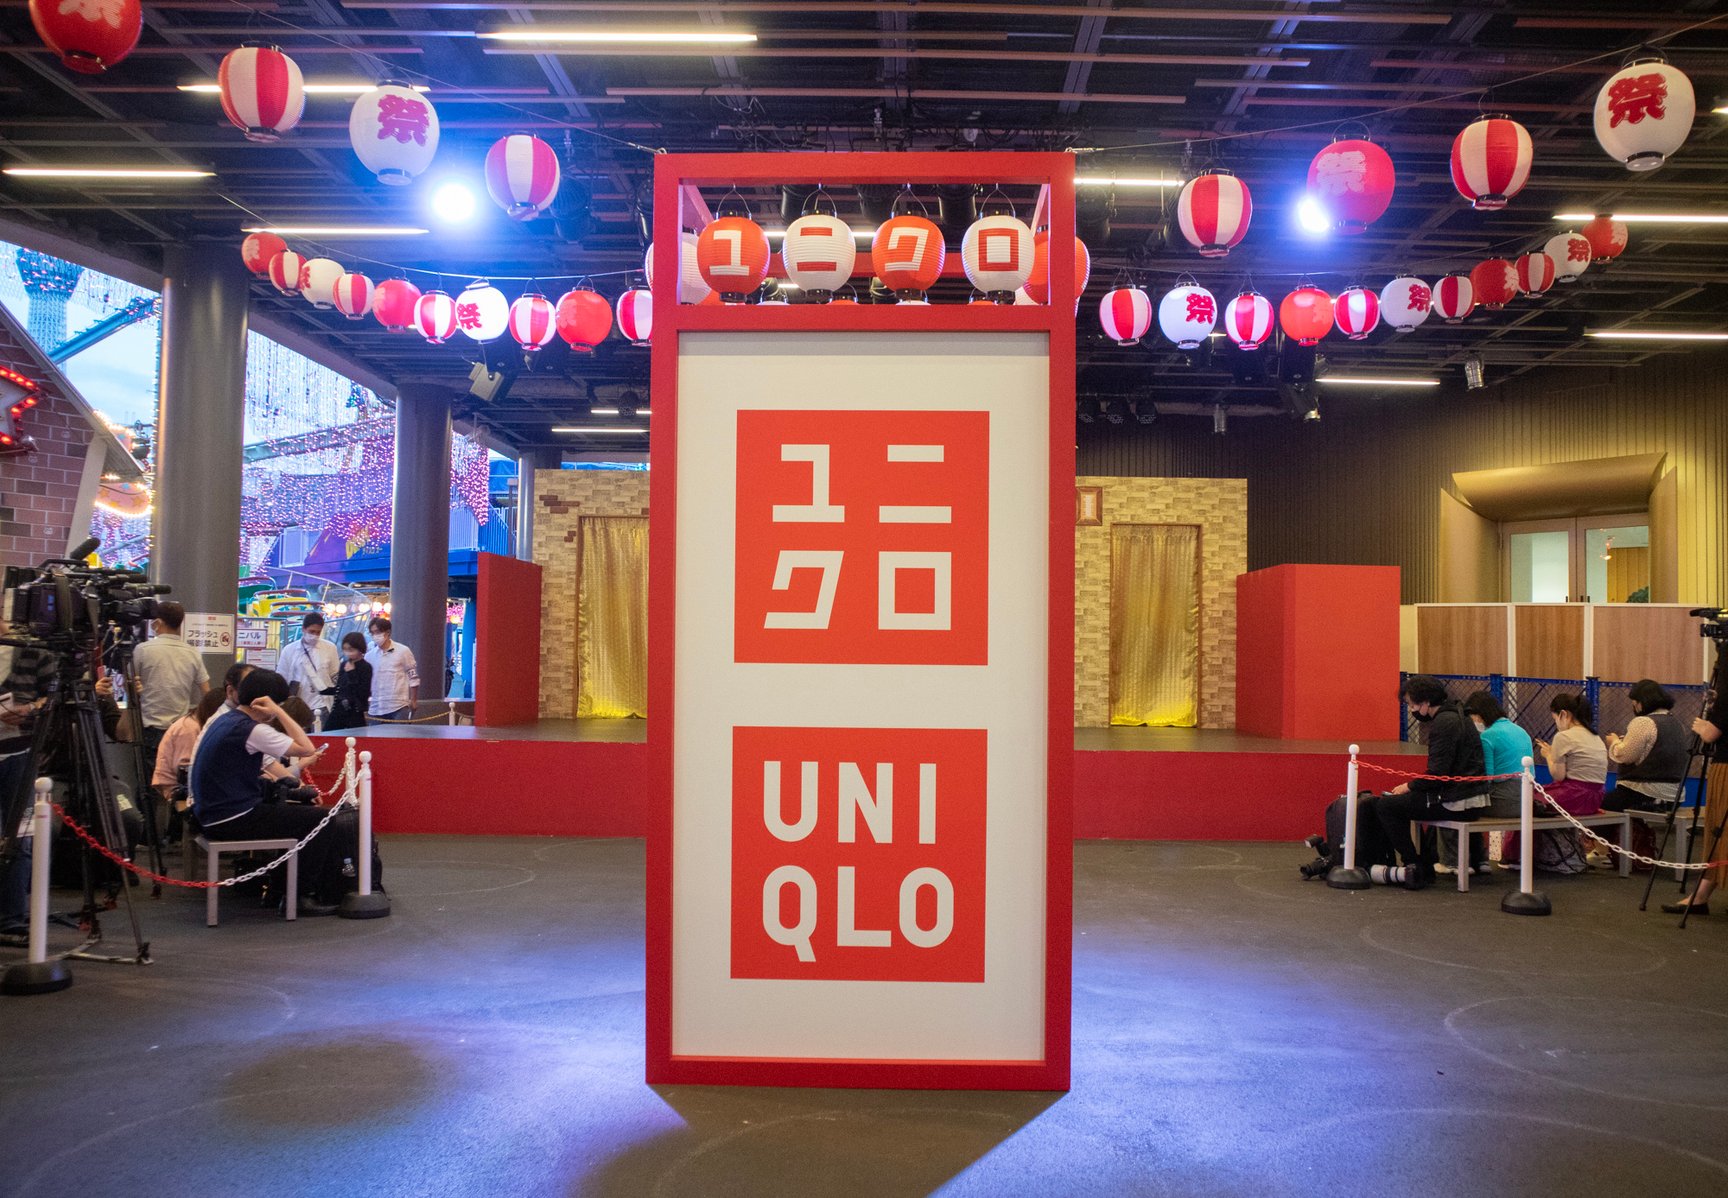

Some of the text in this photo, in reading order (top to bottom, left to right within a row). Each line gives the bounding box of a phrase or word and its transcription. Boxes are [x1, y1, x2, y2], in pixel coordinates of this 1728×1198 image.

[377, 94, 429, 147] 祭
[1608, 73, 1668, 129] 祭
[709, 226, 1019, 277] ユニクロ
[456, 302, 483, 331] 祭
[1186, 293, 1215, 325] 祭
[772, 444, 952, 524] ユニ
[763, 550, 952, 631] クロ
[188, 629, 218, 639] フラッシュ
[763, 760, 937, 845] UNI
[762, 864, 955, 963] QLO
